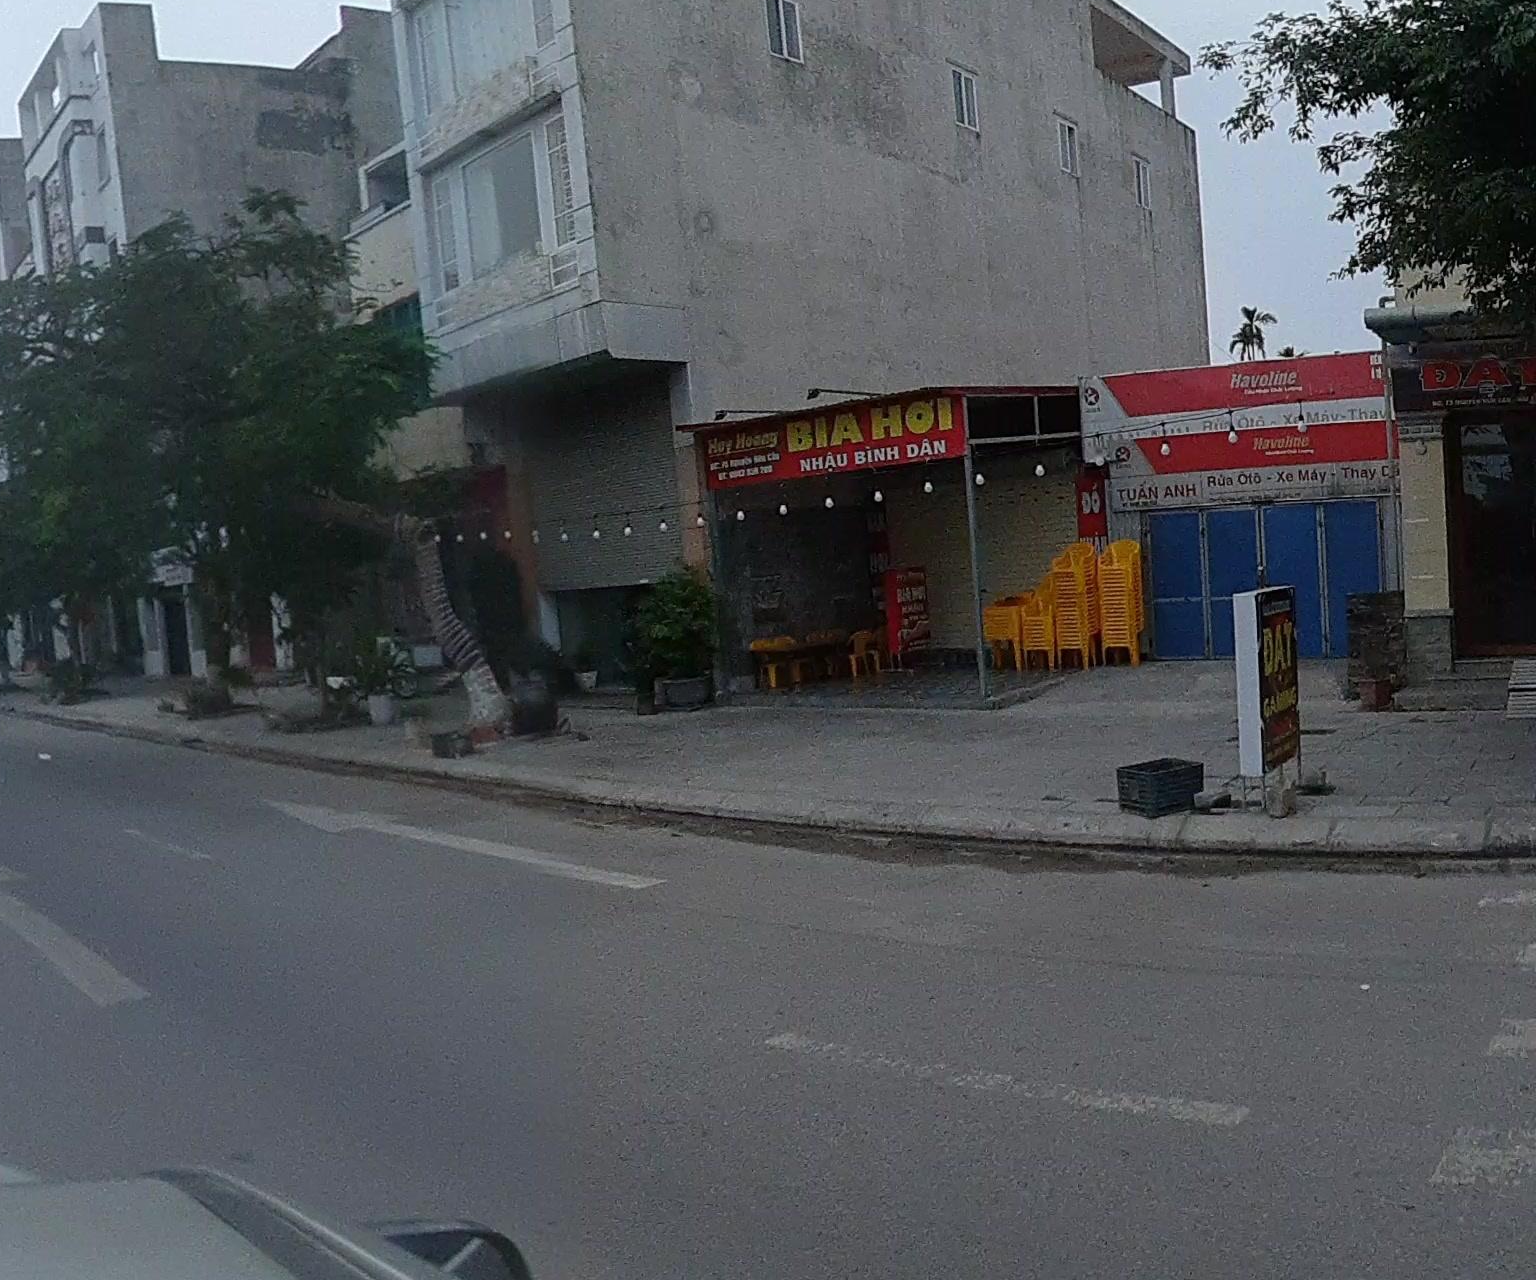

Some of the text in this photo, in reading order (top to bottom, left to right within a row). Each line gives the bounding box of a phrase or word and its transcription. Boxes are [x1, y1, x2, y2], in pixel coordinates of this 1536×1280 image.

[1231, 371, 1298, 389] Havoline
[786, 397, 953, 452] BIA HƠI
[1252, 436, 1309, 451] Havoline
[800, 439, 946, 473] NHẬU BÌNH DÂN
[1207, 475, 1234, 487] Rửa
[1276, 471, 1295, 483] Xe
[1298, 469, 1327, 485] Máy
[1341, 467, 1377, 481] Thay
[1116, 481, 1161, 502] TUẤN
[1164, 483, 1196, 498] ANH
